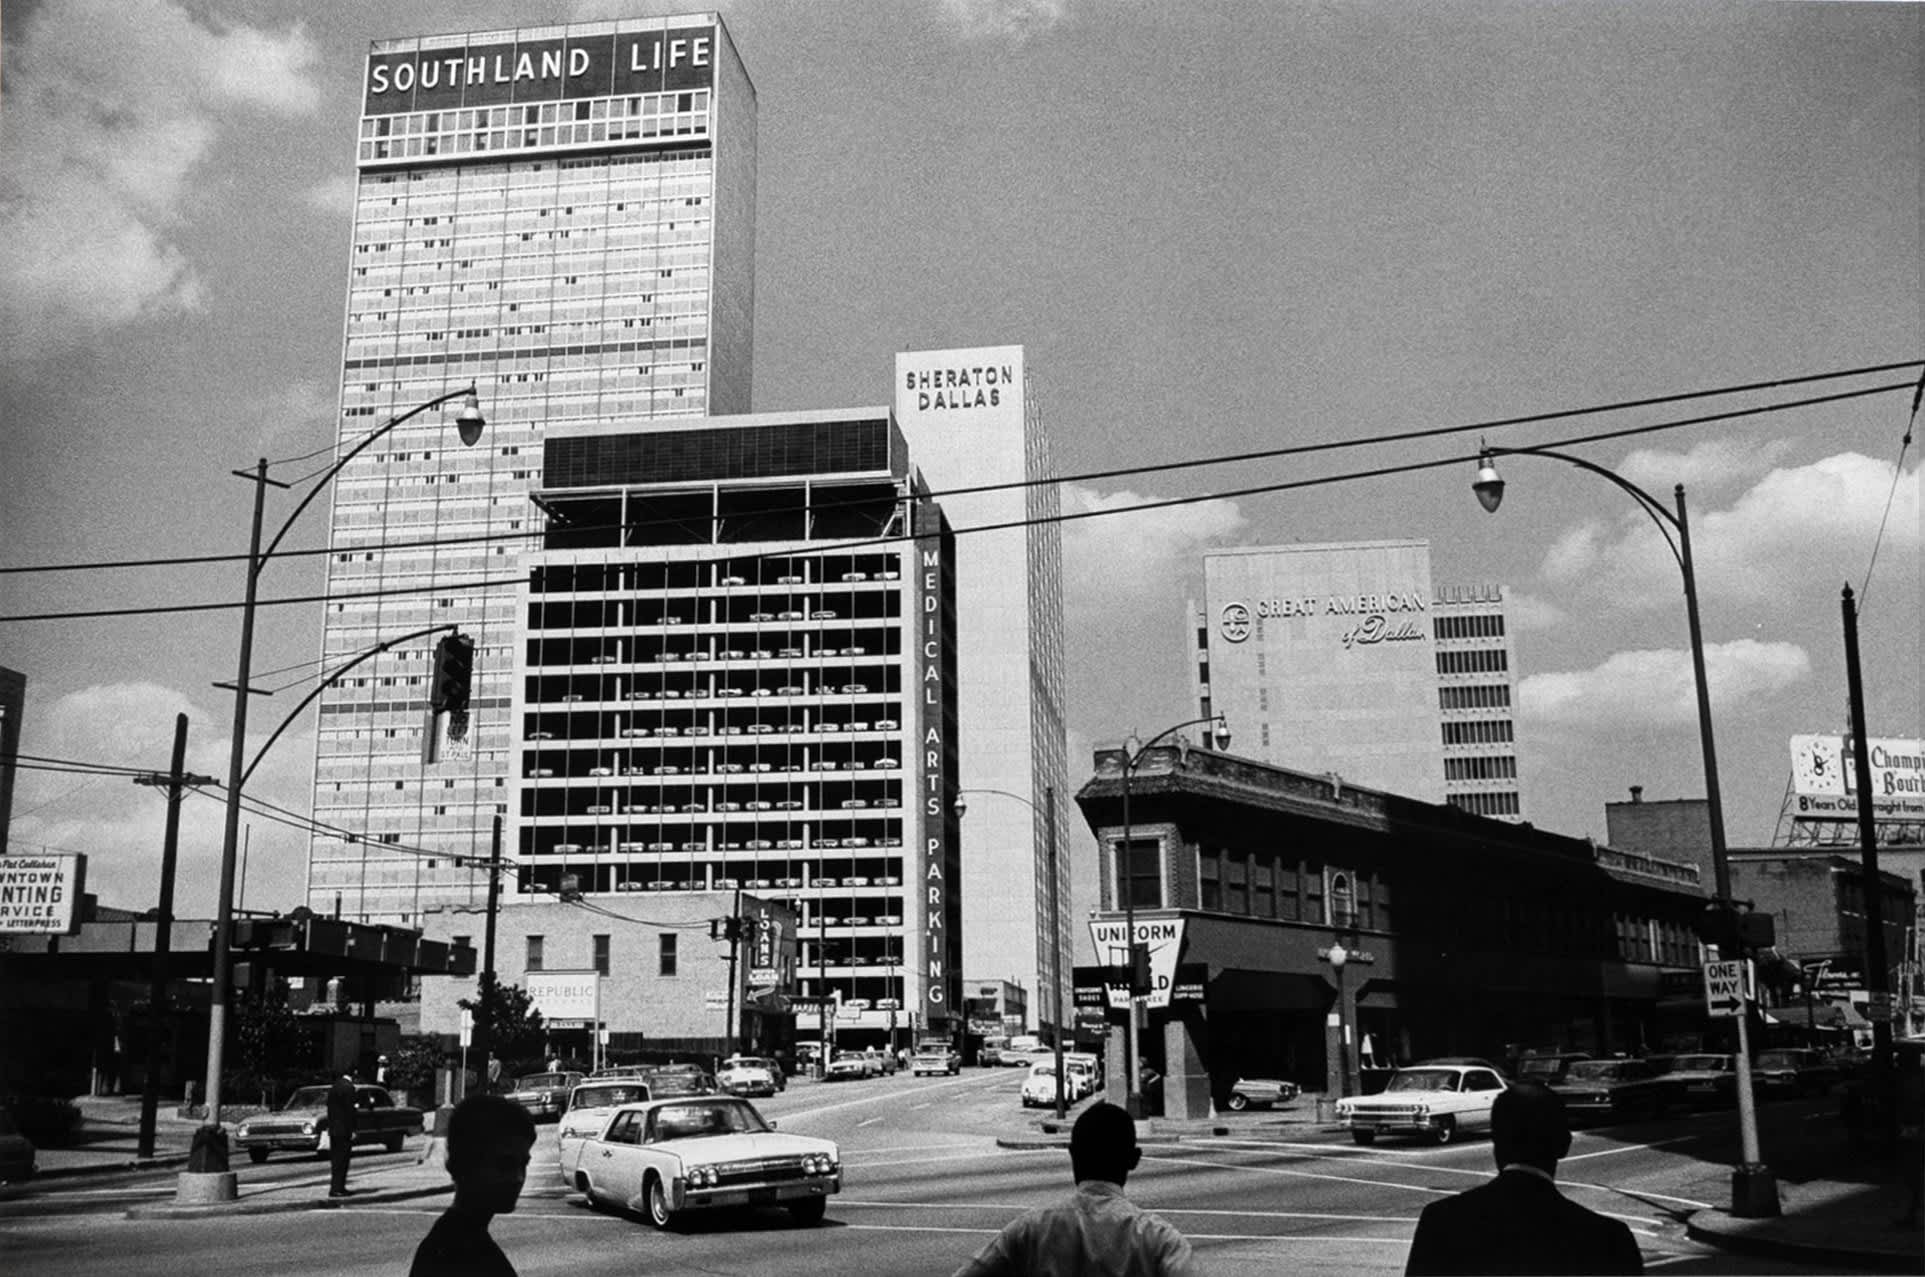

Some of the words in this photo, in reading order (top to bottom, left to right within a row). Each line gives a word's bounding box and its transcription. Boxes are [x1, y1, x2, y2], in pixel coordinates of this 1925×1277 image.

[371, 48, 590, 94] SOUTHLAND
[631, 37, 710, 72] LIFE
[906, 365, 1012, 390] SHERATON
[919, 388, 1000, 411] DALLAS
[1256, 599, 1316, 618] GREAT
[1325, 593, 1425, 616] AMERICAN
[923, 551, 939, 704] MEDICAL
[1357, 615, 1426, 645] Dallas
[925, 727, 940, 815] ARTS
[1799, 795, 1809, 812] 8
[1808, 797, 1836, 811] Years
[2, 886, 62, 903] NTING
[0, 906, 54, 917] RVICE
[927, 838, 943, 1003] PARKING
[7, 920, 61, 928] LETTERPRESS
[1097, 924, 1176, 941] UNIORM
[760, 908, 770, 966] LOANS
[1708, 964, 1737, 979] ONE
[529, 985, 593, 997] REPUBLIC
[1709, 980, 1739, 995] WAY
